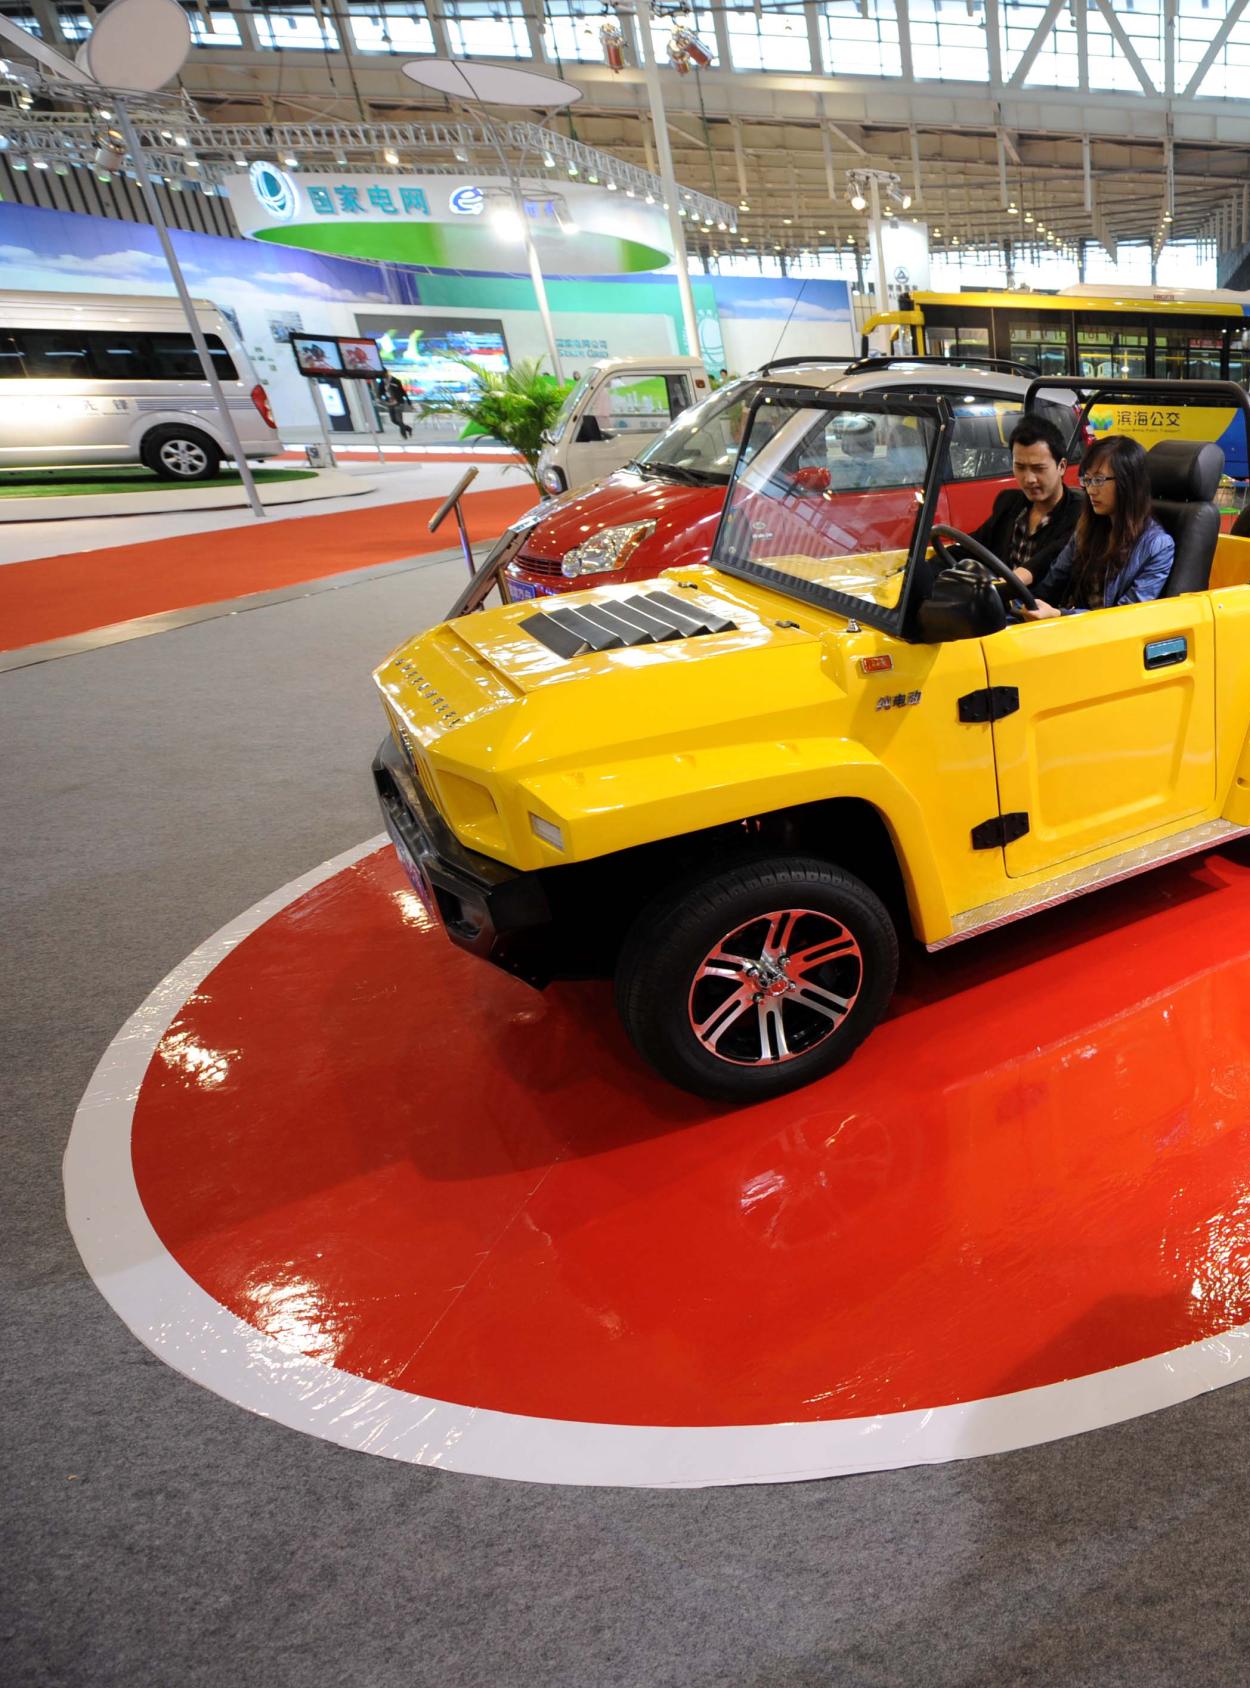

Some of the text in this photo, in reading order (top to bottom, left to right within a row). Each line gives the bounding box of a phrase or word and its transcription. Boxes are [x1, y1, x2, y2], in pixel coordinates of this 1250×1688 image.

[306, 184, 430, 216] 国家电网
[1117, 410, 1182, 427] 滨海公交
